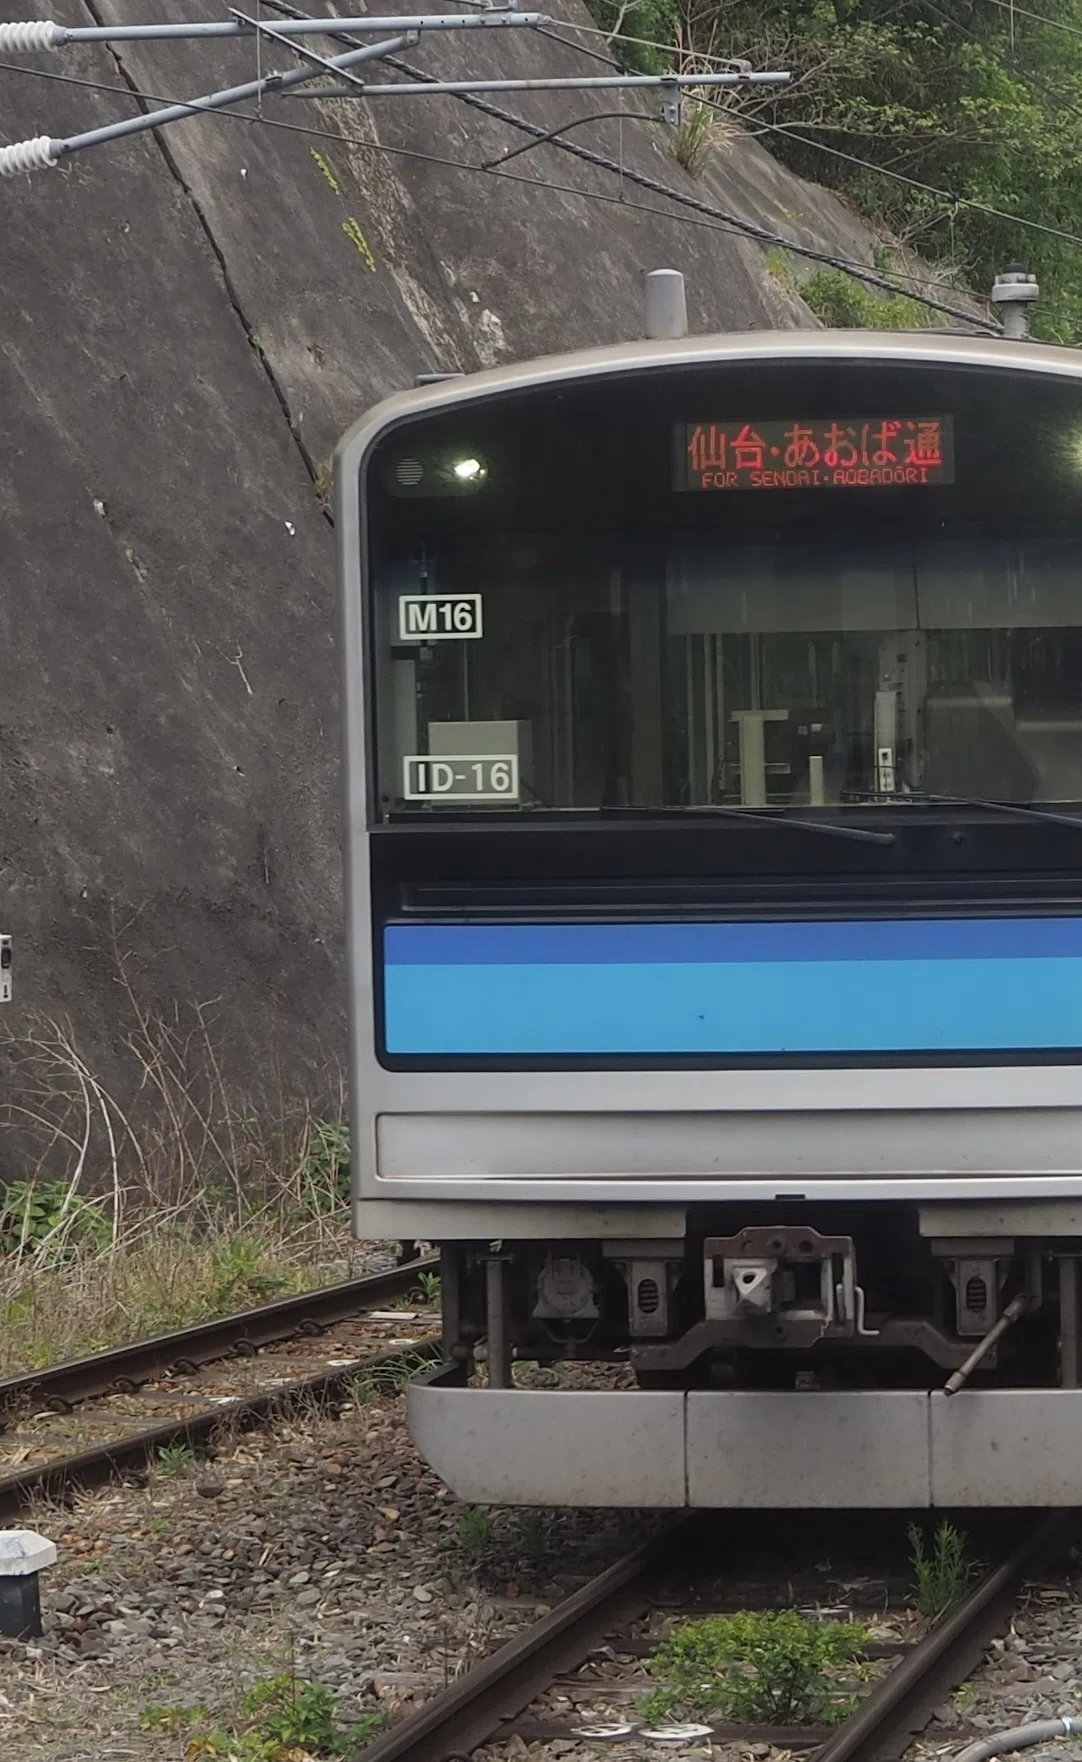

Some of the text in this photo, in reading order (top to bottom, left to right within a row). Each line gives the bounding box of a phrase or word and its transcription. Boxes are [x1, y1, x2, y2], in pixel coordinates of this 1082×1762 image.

[702, 473, 739, 488] FOR
[408, 602, 473, 632] M16
[418, 762, 510, 792] ID-16
